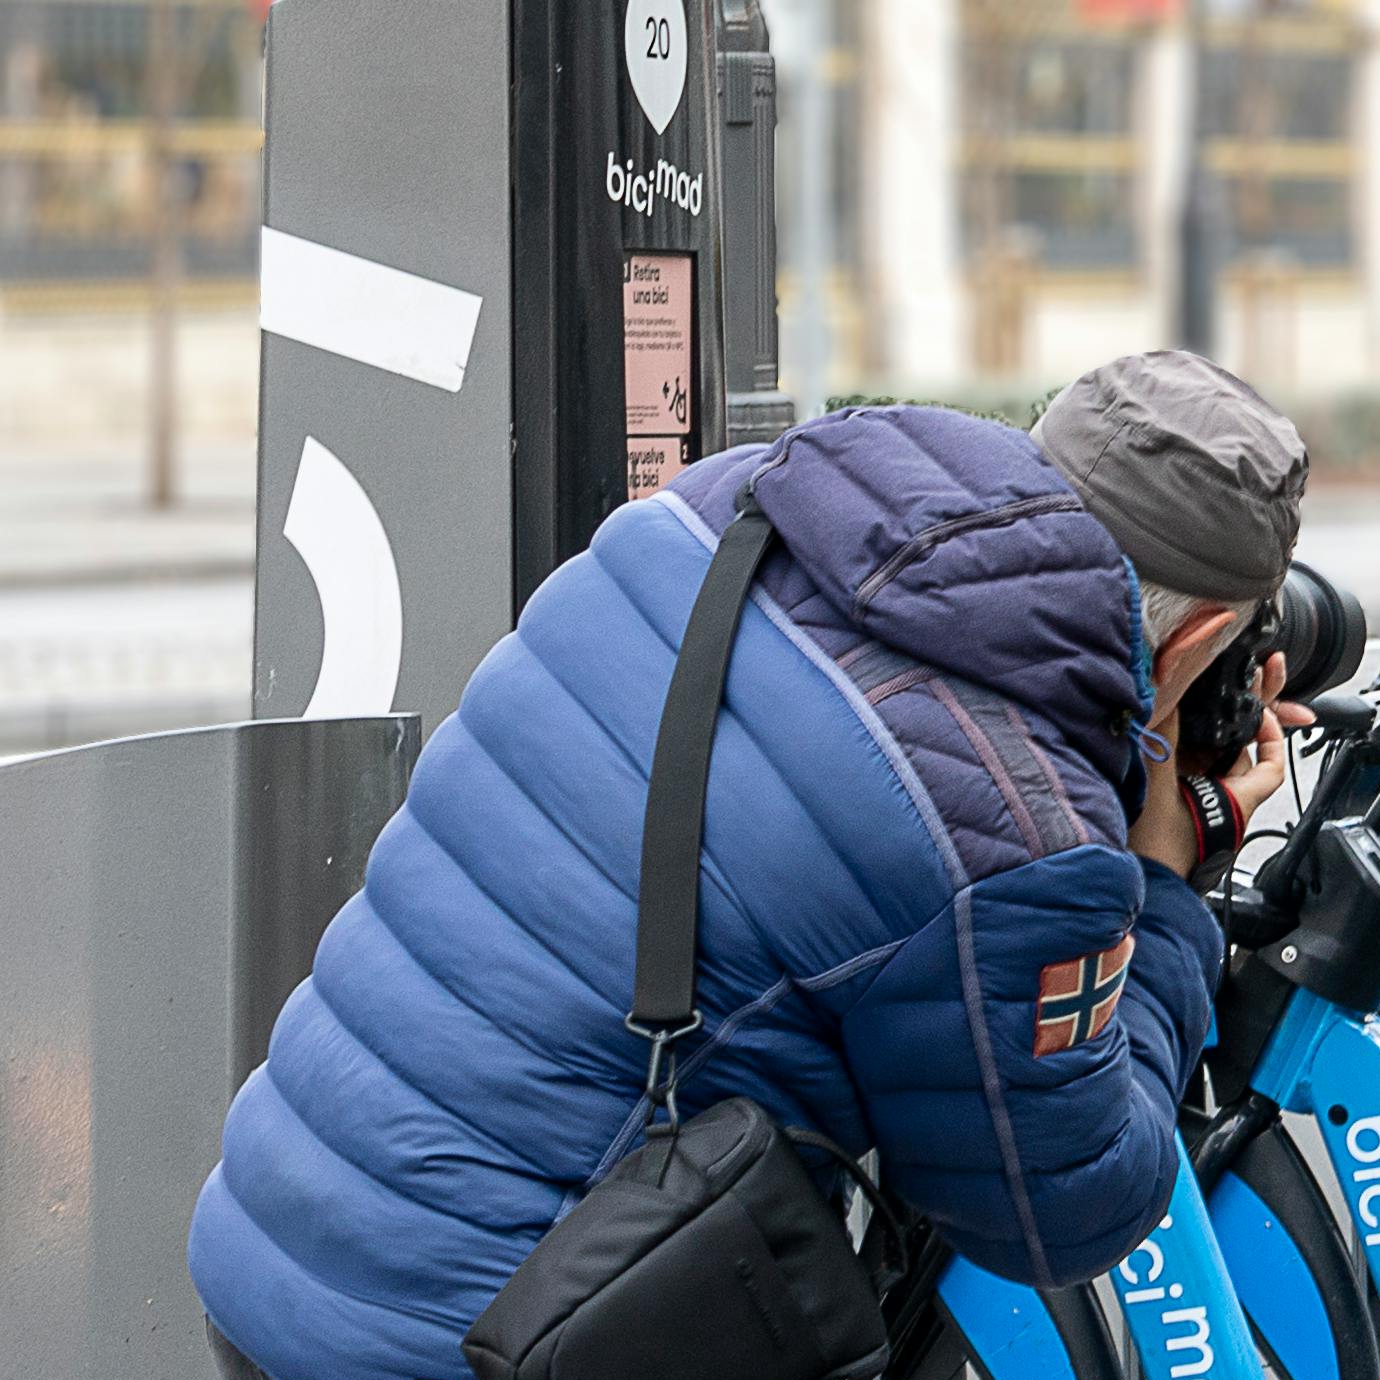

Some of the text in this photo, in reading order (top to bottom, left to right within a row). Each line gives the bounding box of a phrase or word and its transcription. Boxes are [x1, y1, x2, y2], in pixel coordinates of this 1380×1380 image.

[645, 16, 670, 60] 20
[633, 263, 660, 281] Retira
[633, 285, 670, 304] una bici
[628, 447, 665, 465] evuelve
